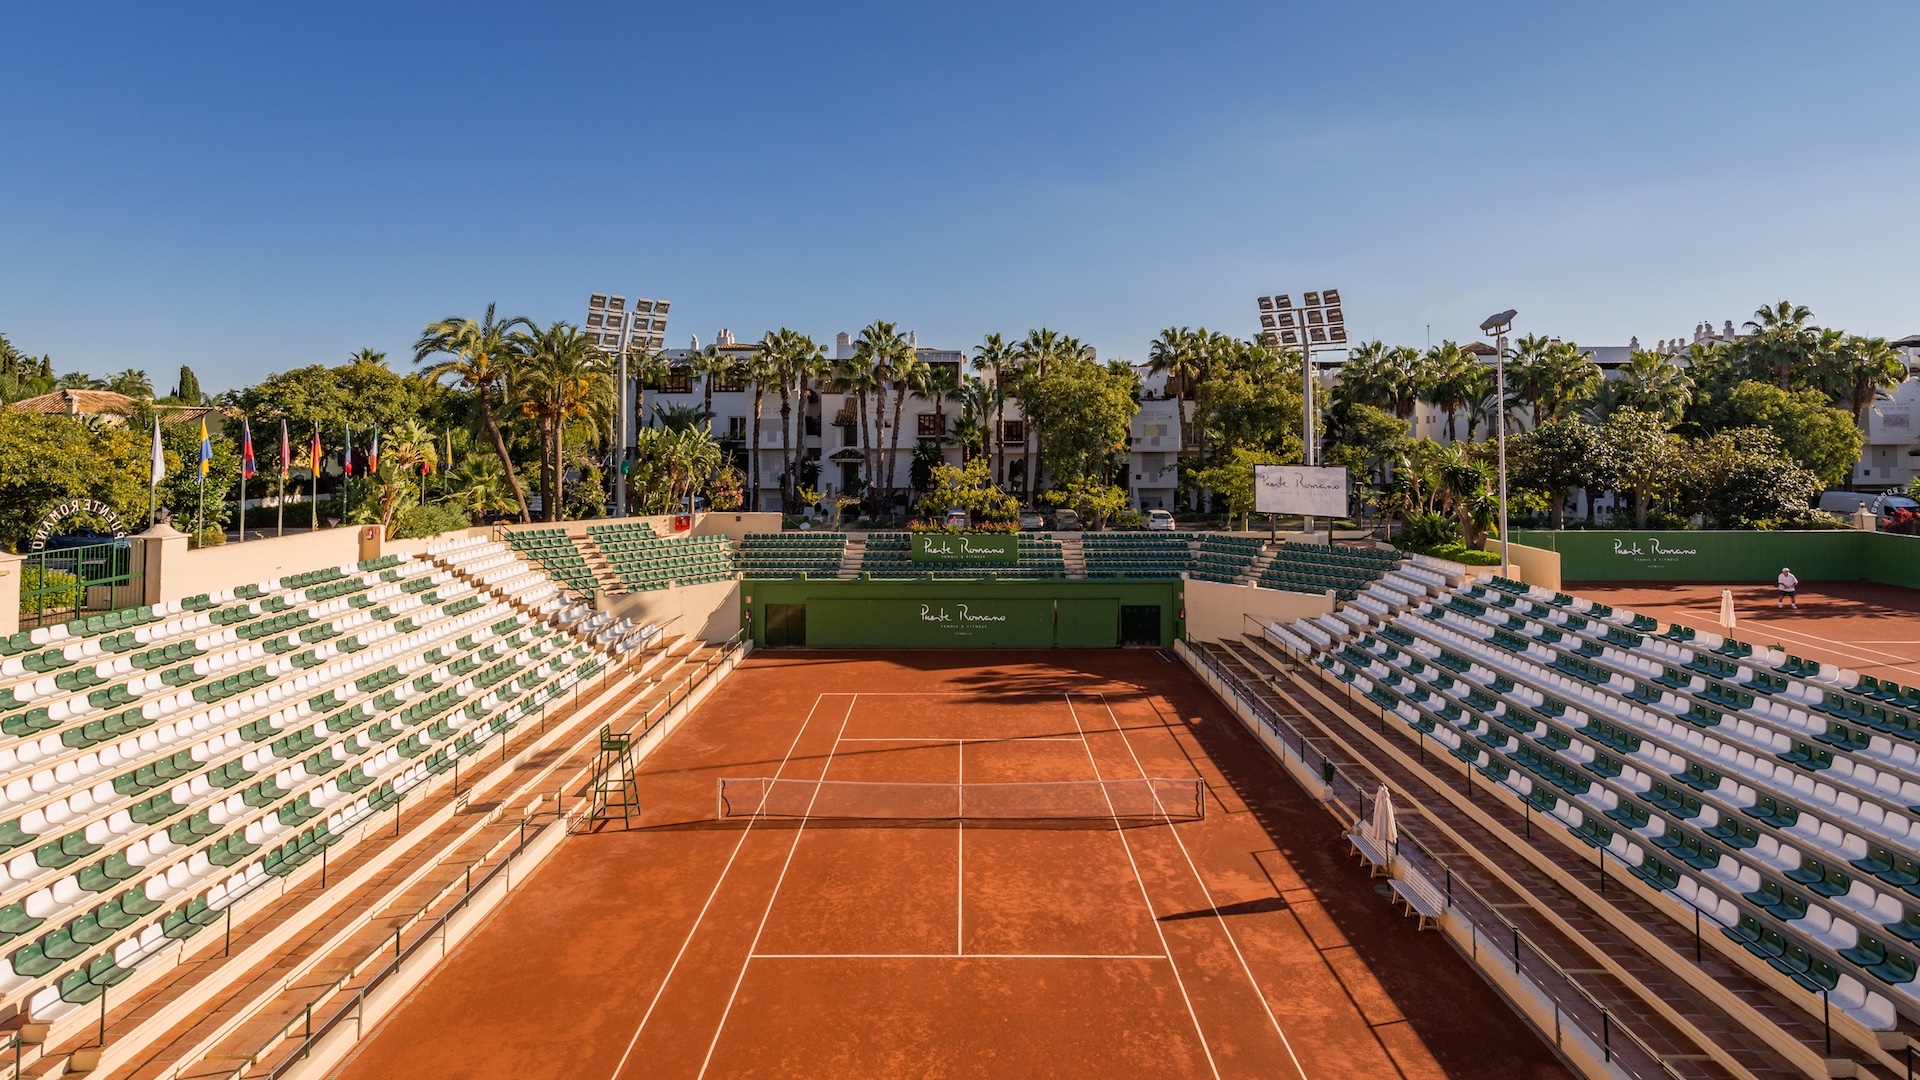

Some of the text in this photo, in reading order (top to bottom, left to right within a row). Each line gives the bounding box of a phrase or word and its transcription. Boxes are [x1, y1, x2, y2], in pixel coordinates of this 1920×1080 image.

[1262, 472, 1340, 490] Puente Romano
[924, 537, 1005, 554] Puente Romano
[1613, 538, 1696, 555] Puente Romano
[920, 603, 1006, 622] Puente Romano
